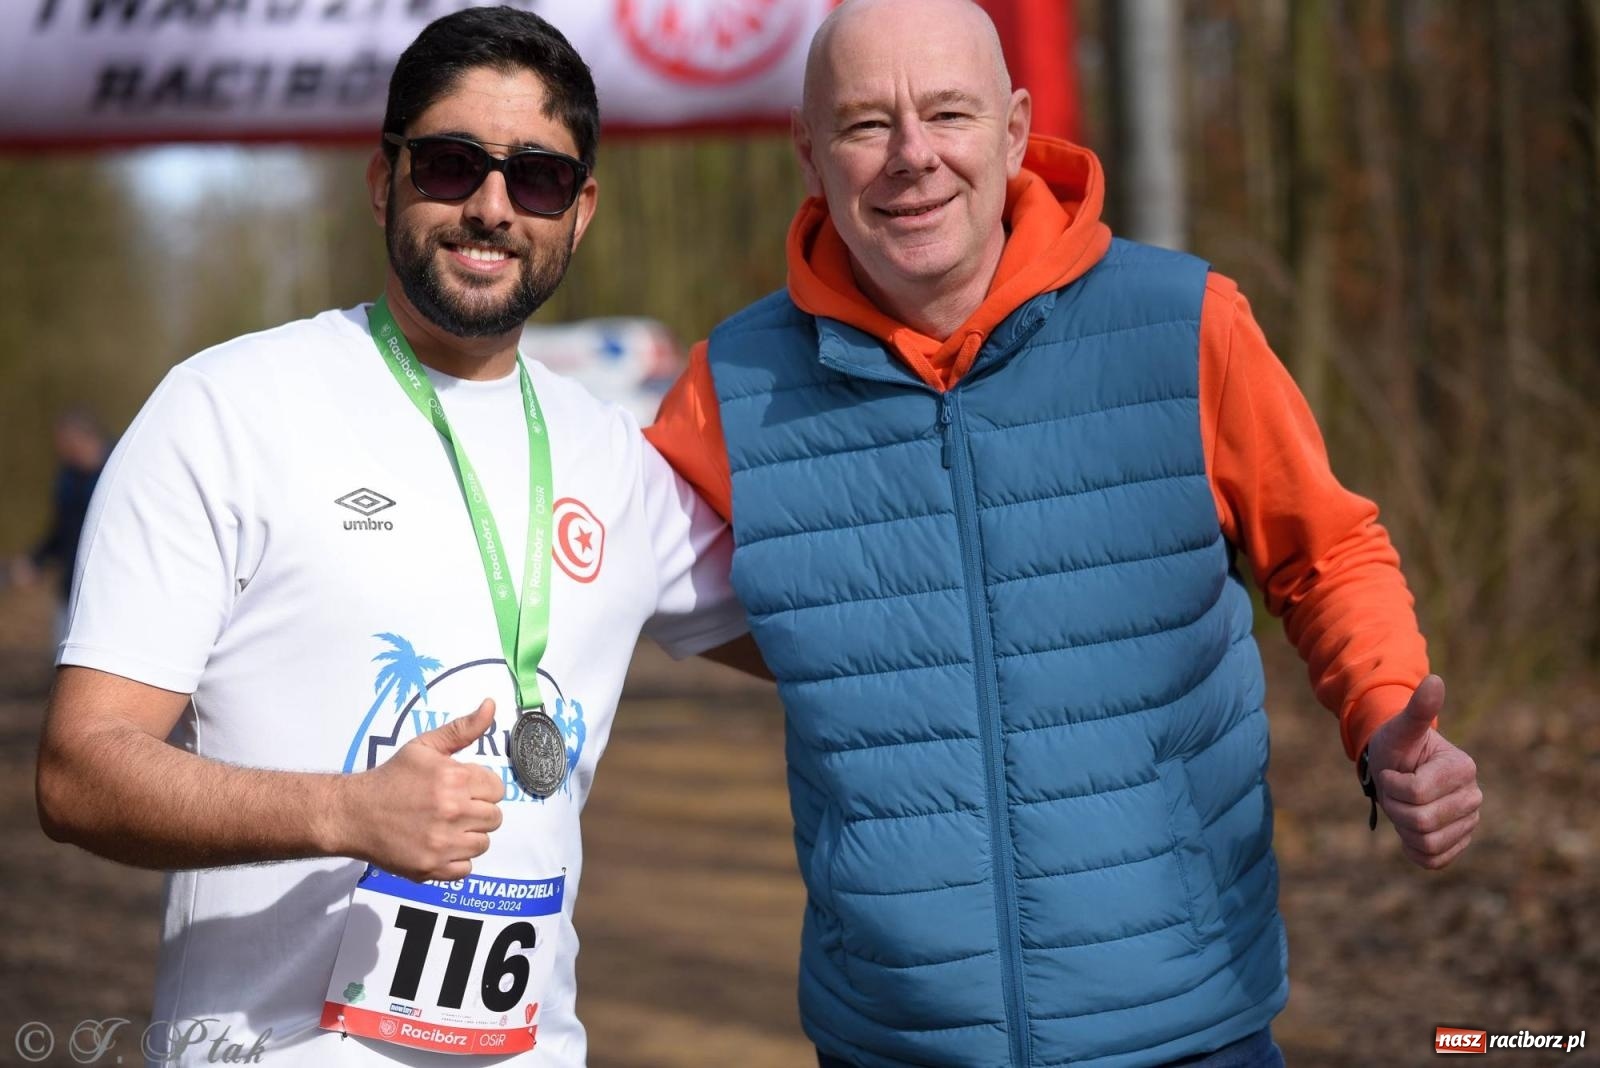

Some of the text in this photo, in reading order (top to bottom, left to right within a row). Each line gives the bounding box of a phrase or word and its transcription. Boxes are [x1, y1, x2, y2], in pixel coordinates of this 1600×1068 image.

[386, 336, 422, 391] Racibórz
[343, 516, 393, 532] umbro
[530, 485, 545, 588] Racibórz OSiR
[481, 518, 503, 580] Racibórz
[442, 892, 522, 911] 25 lutego 2024
[467, 879, 554, 899] TWARDZIELA
[388, 904, 537, 1013] 116
[401, 1023, 507, 1047] Racibórz OSiR
